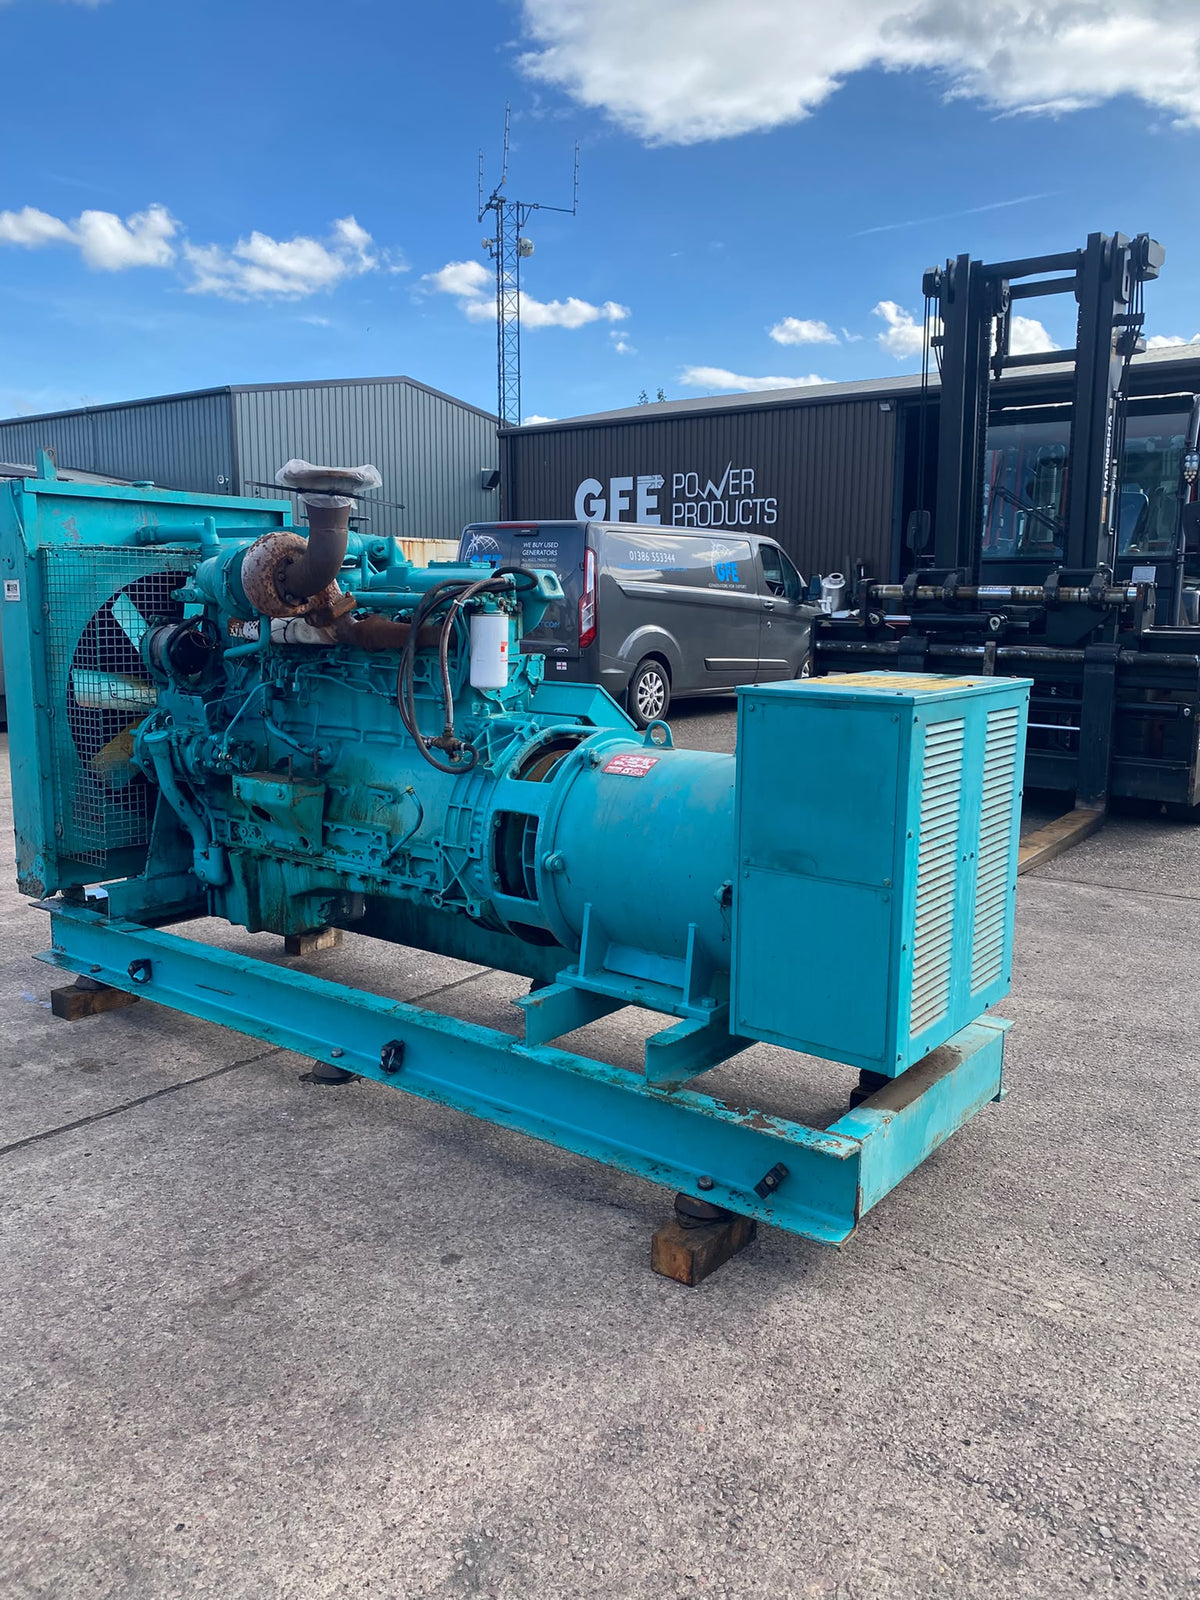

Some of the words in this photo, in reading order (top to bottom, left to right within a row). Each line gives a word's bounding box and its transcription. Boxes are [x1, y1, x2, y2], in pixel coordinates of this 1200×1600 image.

[1103, 414, 1112, 492] HANGCHA
[672, 460, 755, 499] POWER
[574, 474, 665, 525] GFE
[672, 497, 778, 527] PRODUCTS
[543, 541, 559, 549] USED
[629, 550, 650, 562] 01386
[651, 552, 676, 563] 553344
[716, 562, 740, 583] GFE
